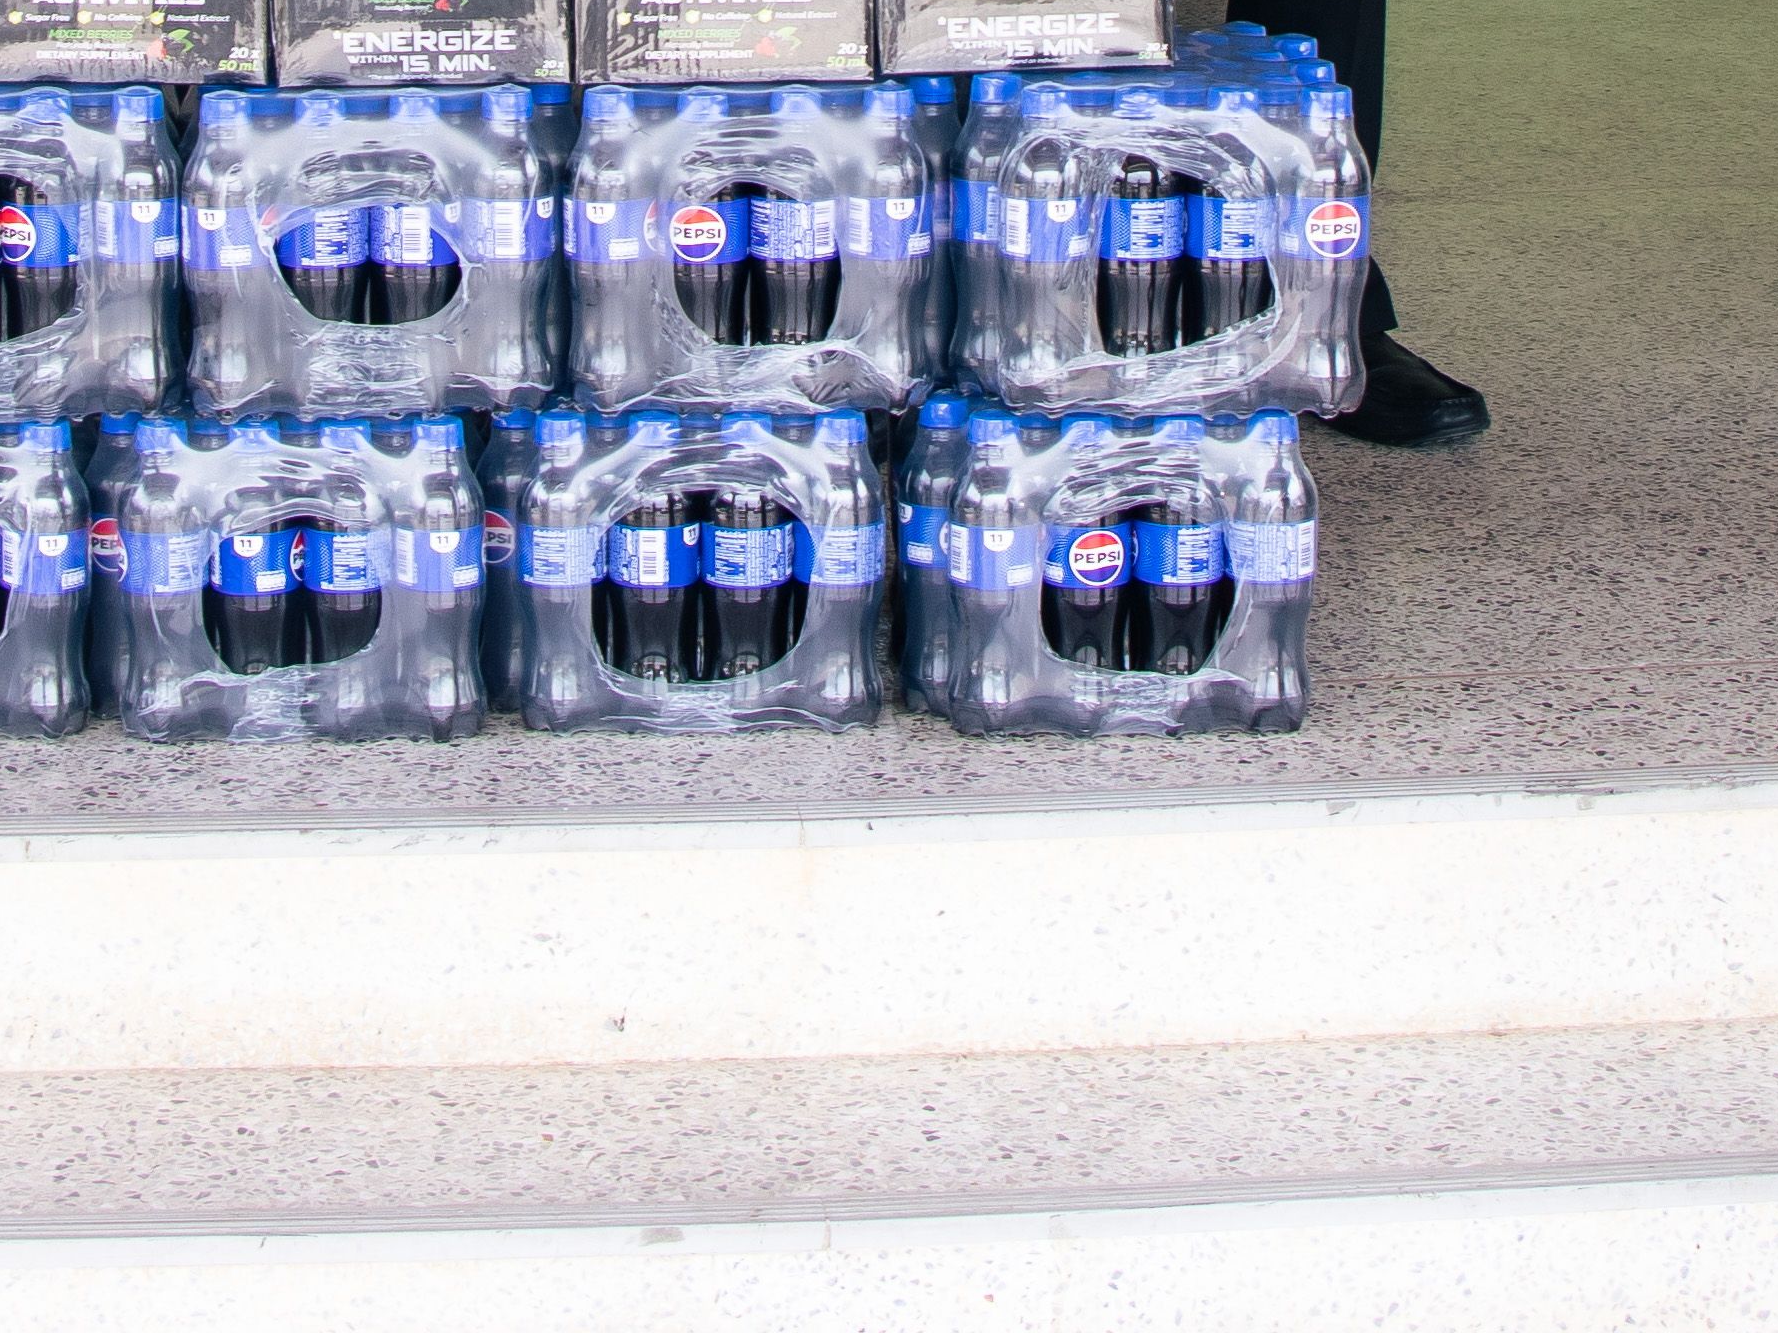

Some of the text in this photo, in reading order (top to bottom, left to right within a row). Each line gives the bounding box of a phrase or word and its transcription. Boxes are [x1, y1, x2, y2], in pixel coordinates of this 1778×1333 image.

[1004, 40, 1034, 58] 15
[400, 54, 430, 73] 15
[674, 227, 721, 239] PEPSI
[1309, 223, 1358, 235] PEPSI
[239, 538, 252, 549] 11
[1073, 550, 1121, 565] PEPSI
